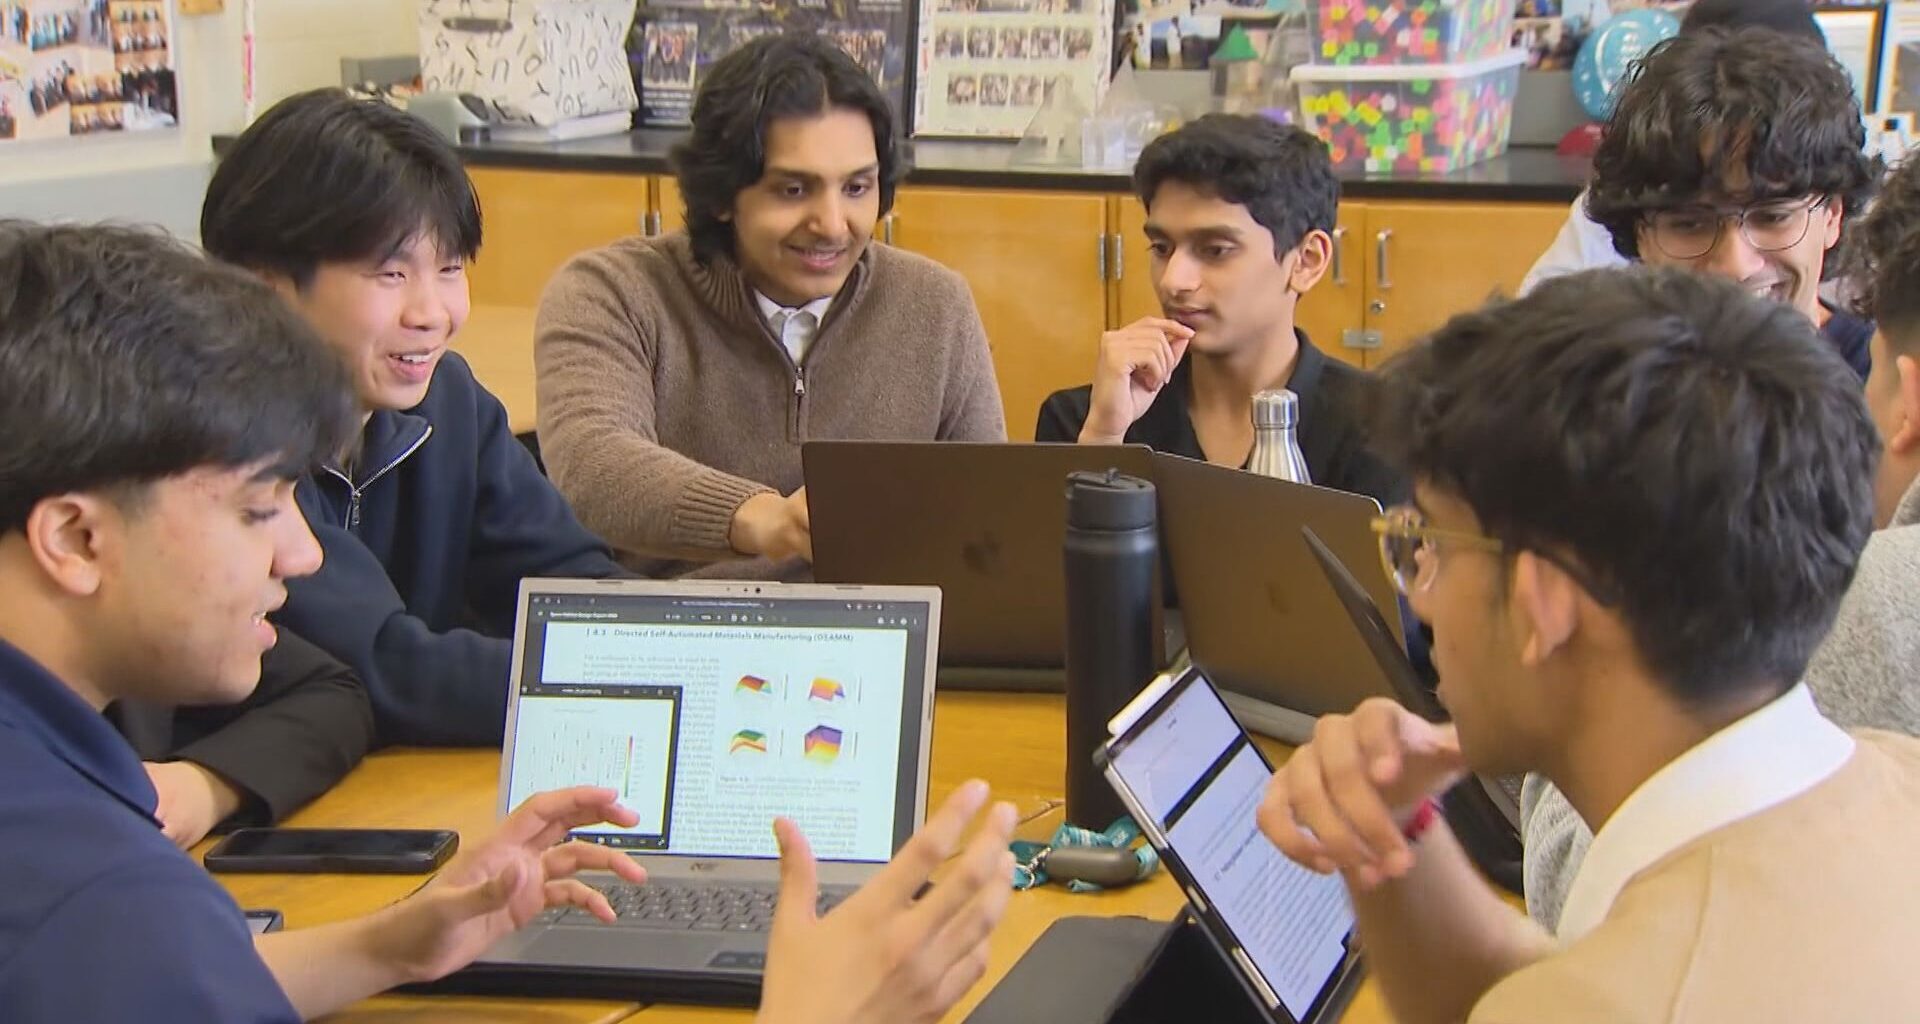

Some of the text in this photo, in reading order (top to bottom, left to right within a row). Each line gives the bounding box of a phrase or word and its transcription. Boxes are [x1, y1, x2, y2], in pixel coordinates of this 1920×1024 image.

[614, 628, 649, 638] Directed
[714, 630, 752, 639] Materials
[753, 631, 812, 642] Manufacturing
